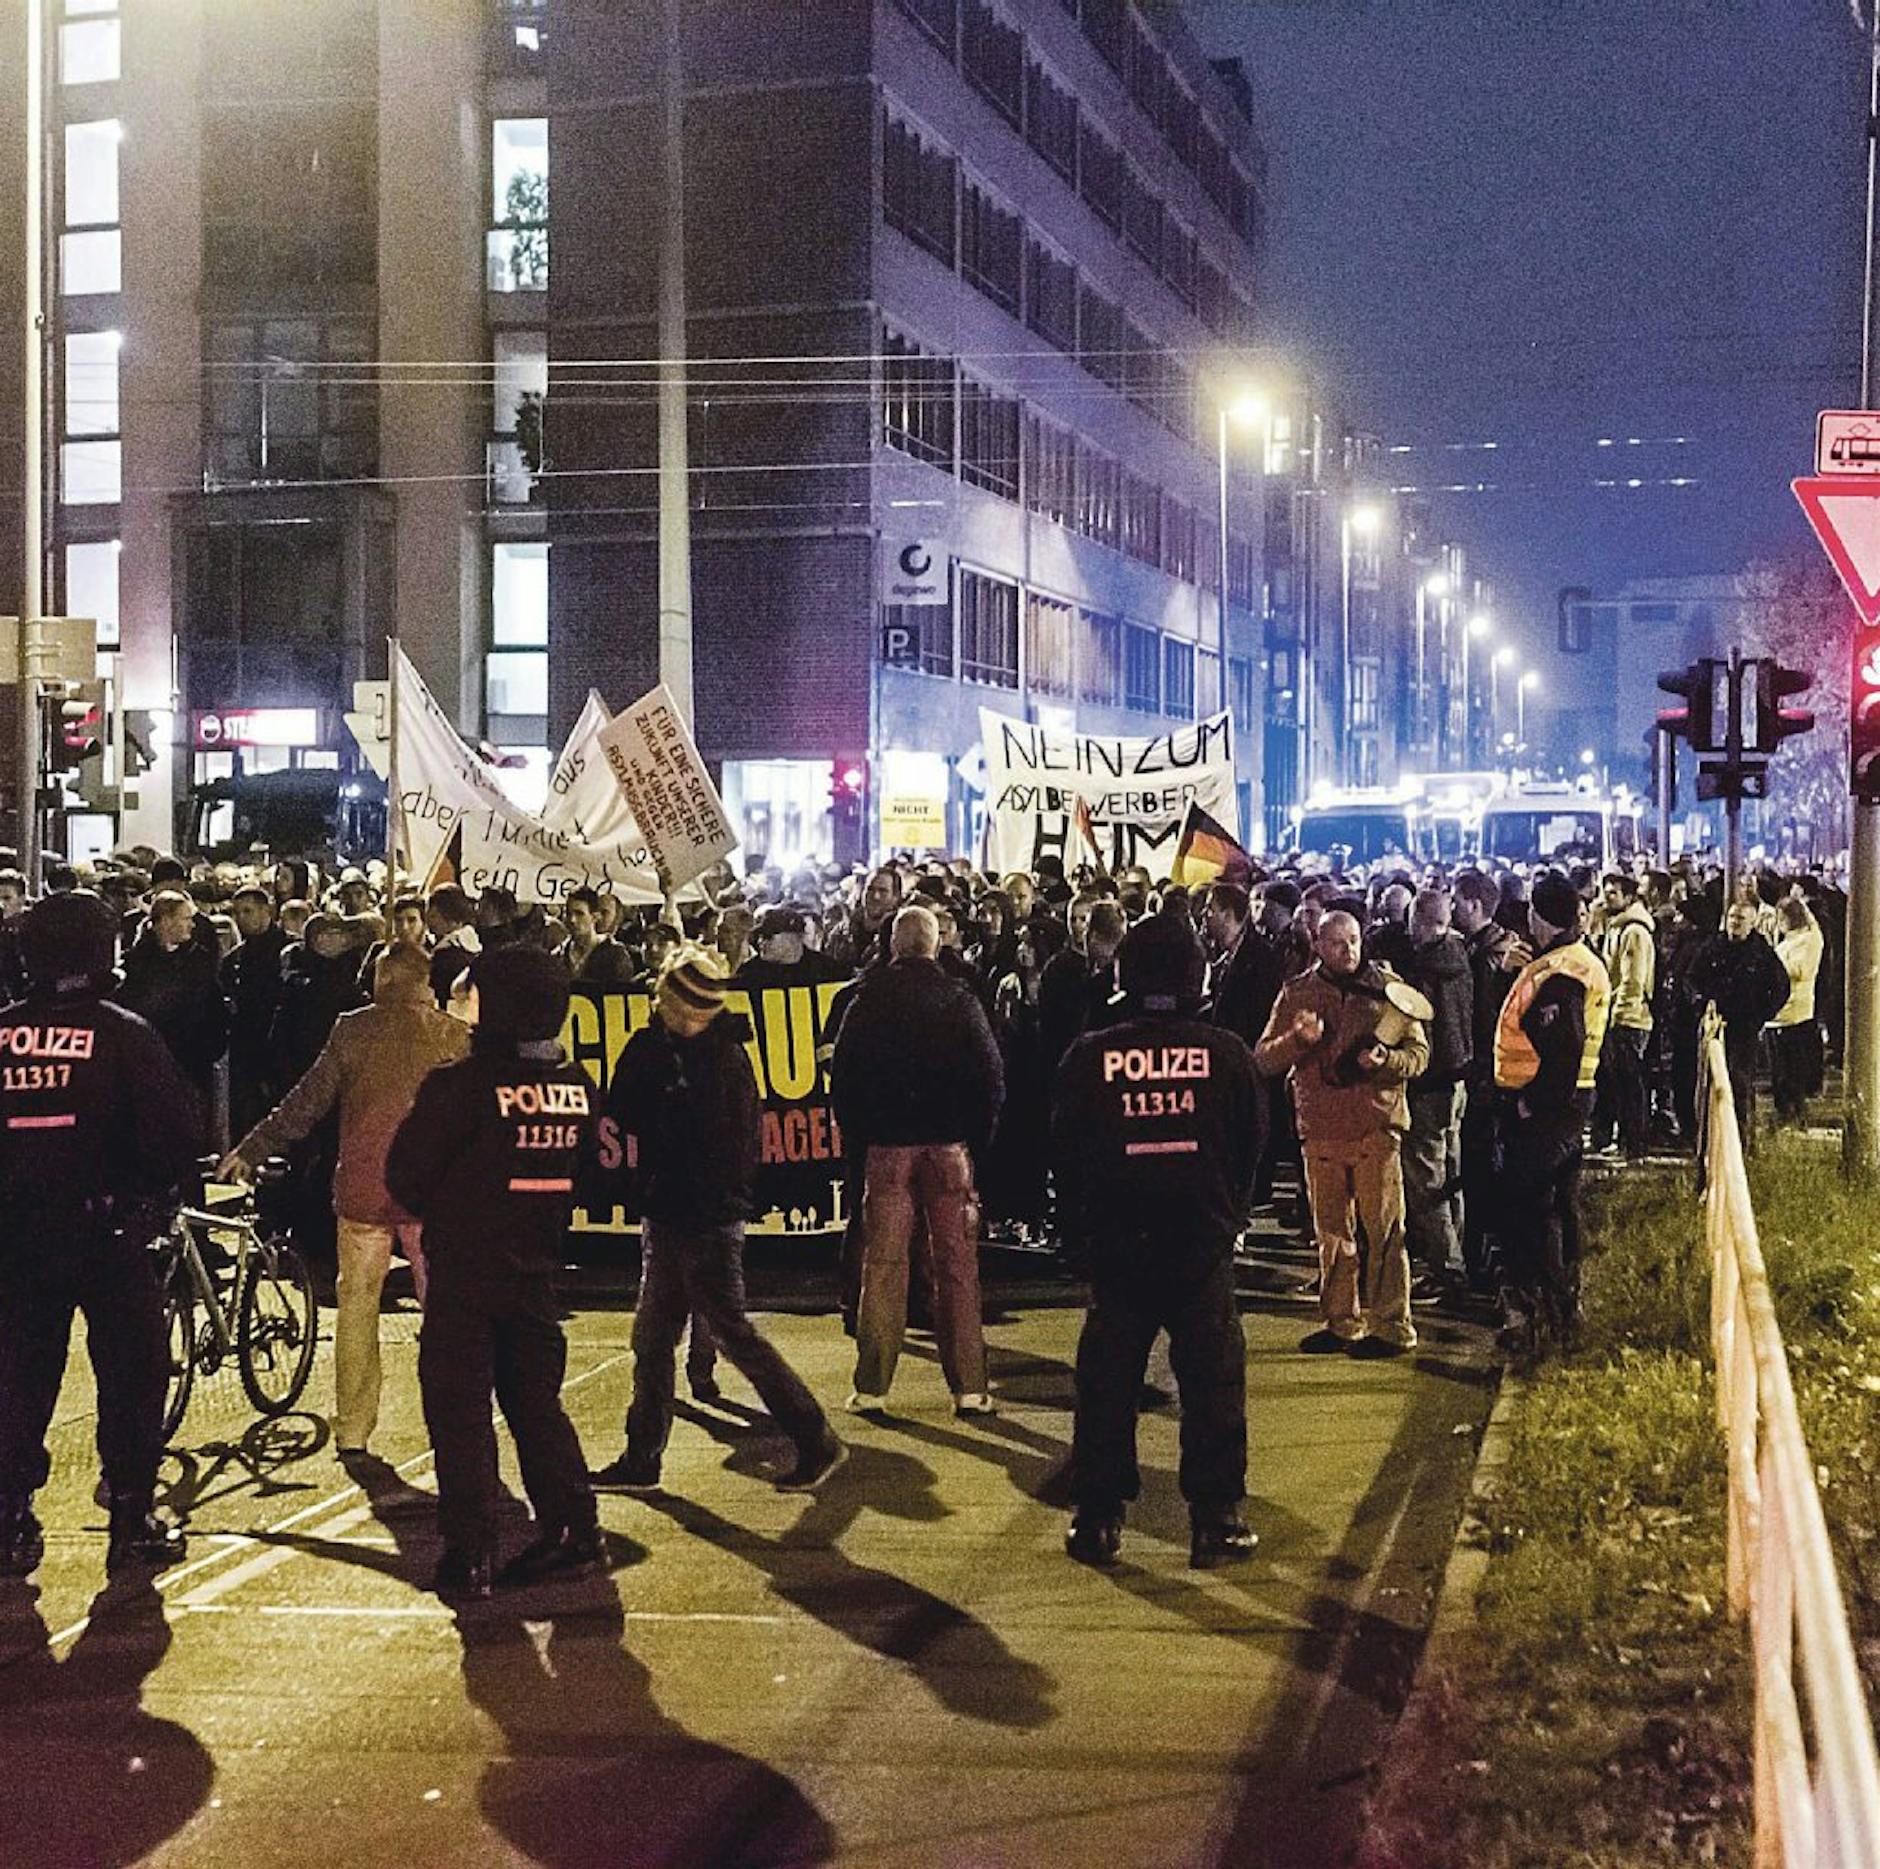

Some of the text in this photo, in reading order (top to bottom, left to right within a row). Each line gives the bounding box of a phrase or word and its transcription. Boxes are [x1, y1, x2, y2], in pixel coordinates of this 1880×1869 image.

[888, 628, 910, 658] P
[1002, 714, 1230, 777] NEIN ZUM
[635, 712, 706, 848] ZUKUNFT UNSERER
[651, 706, 725, 845] FÜR EINE SICHERE
[400, 783, 470, 831] abe
[1031, 813, 1182, 876] HIM
[0, 1025, 95, 1060] POLIZEI
[3, 1063, 72, 1091] 11317
[1103, 1047, 1210, 1082] POLIZEI
[495, 1082, 589, 1118] POLIZEI
[1121, 1088, 1196, 1117] 11314
[515, 1123, 579, 1150] 11316
